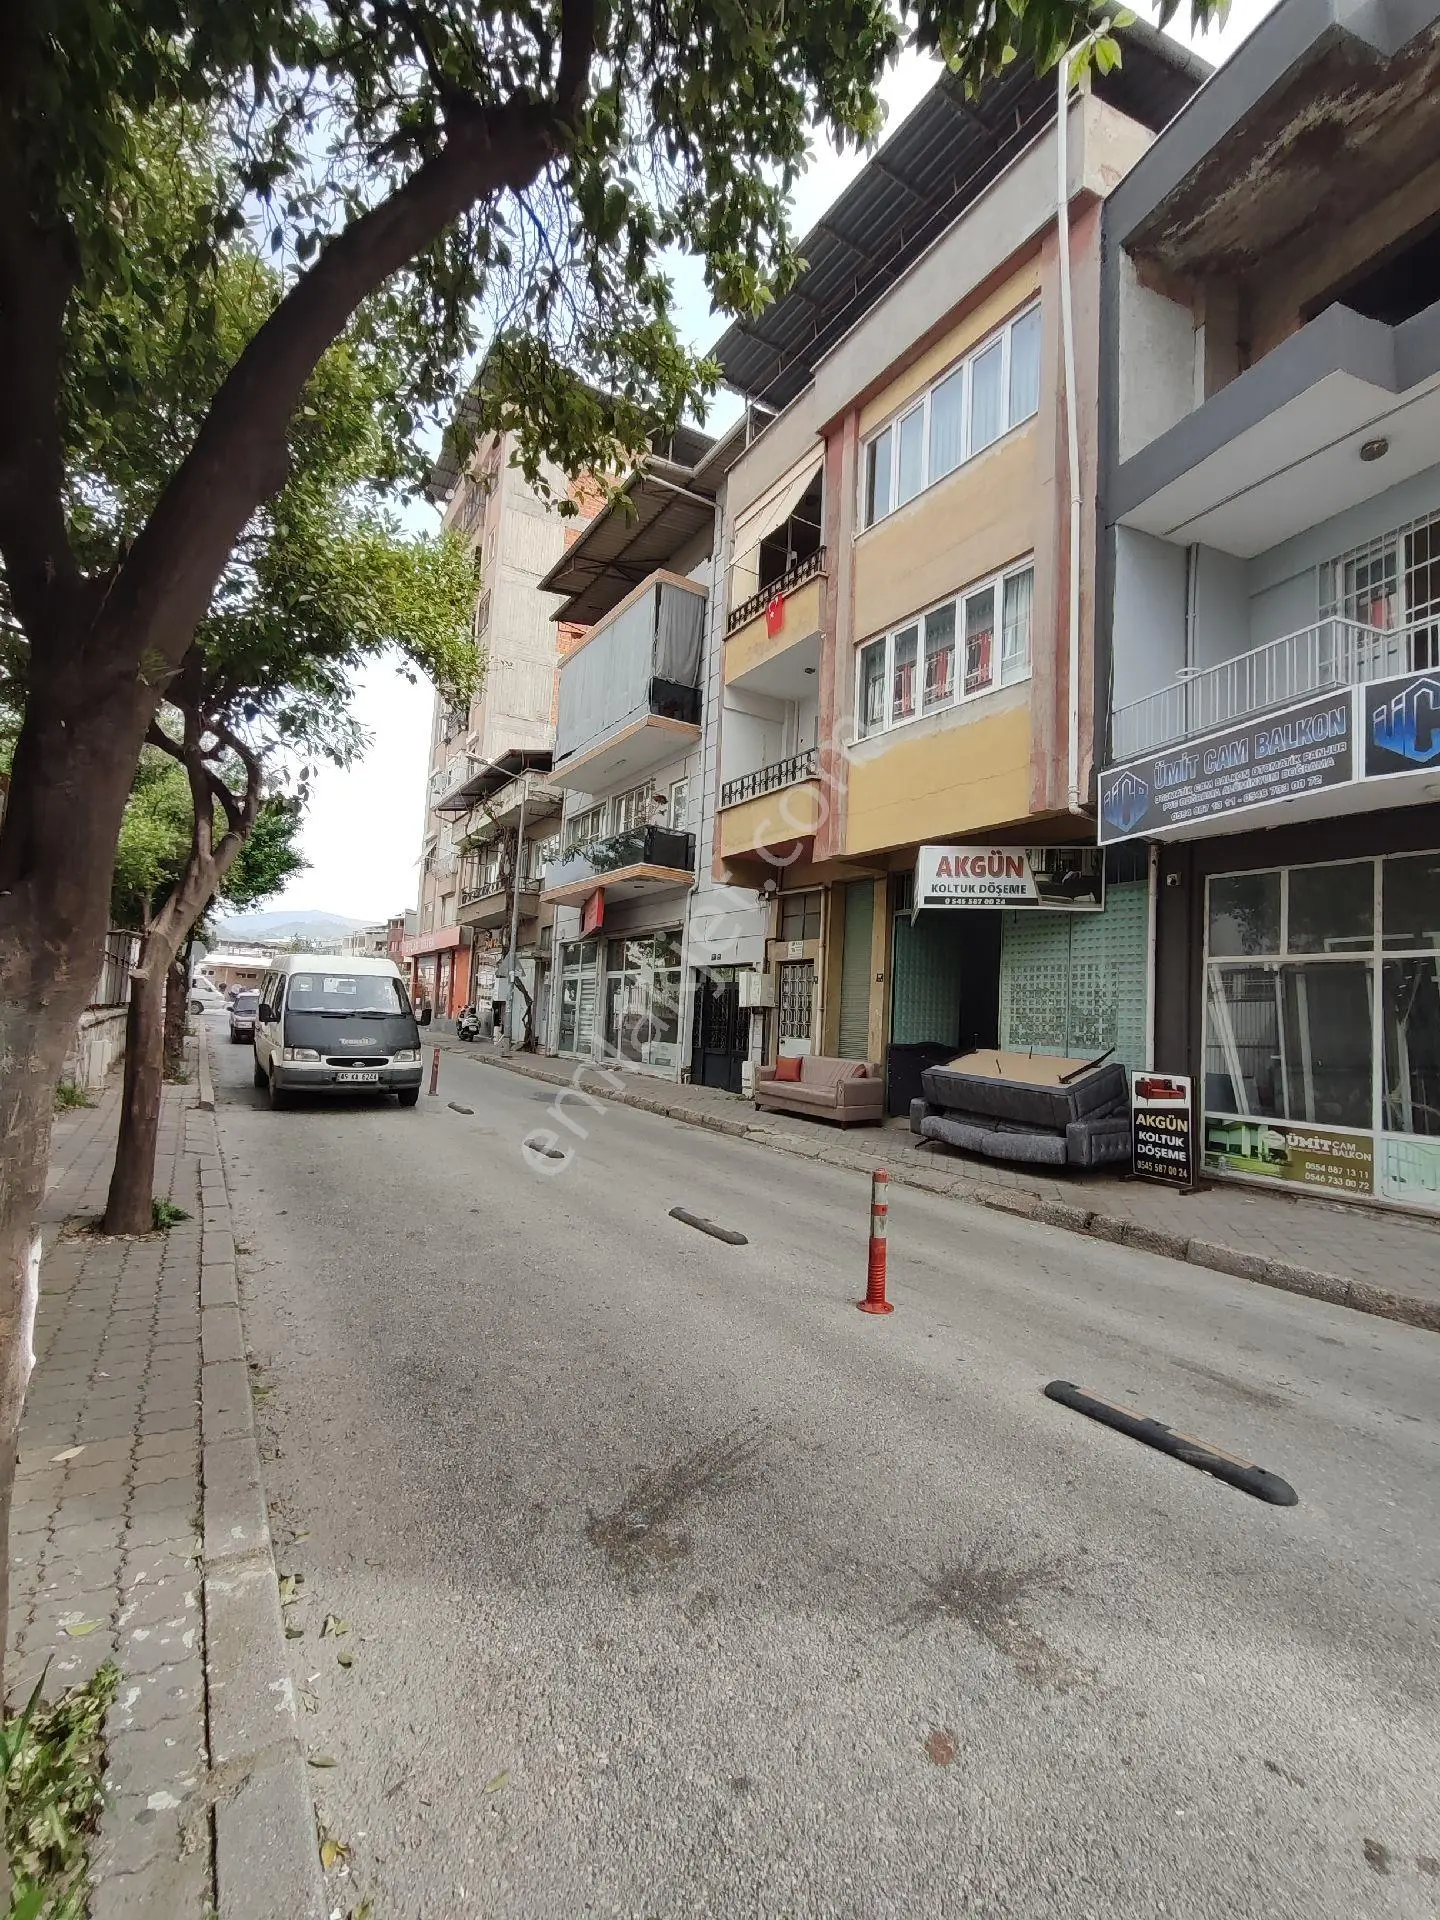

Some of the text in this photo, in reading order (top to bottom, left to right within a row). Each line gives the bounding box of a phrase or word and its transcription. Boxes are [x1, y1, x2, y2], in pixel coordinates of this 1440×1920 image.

[1153, 706, 1347, 789] ÜMİT CAM BALKON
[1214, 768, 1250, 788] BALKON
[1251, 754, 1301, 779] OTOMATİK
[1302, 742, 1347, 762] PANJUR
[1281, 757, 1335, 779] DOĞRAMA
[936, 850, 1024, 878] AKGÜN
[932, 882, 1026, 896] KOLTUK DÖŞEME
[1136, 1113, 1188, 1132] AKGÜN
[1138, 1131, 1184, 1147] KOLTUK
[1286, 1133, 1331, 1151] ÜMİT
[1332, 1141, 1356, 1152] CAM
[1137, 1143, 1187, 1161] DÖŞEME
[1332, 1148, 1372, 1162] BALKON
[1137, 1160, 1188, 1179] 0545 587 00 24
[1346, 1168, 1356, 1177] 13
[1359, 1170, 1369, 1179] 11
[1305, 1172, 1370, 1190] 0546 733 00 72
